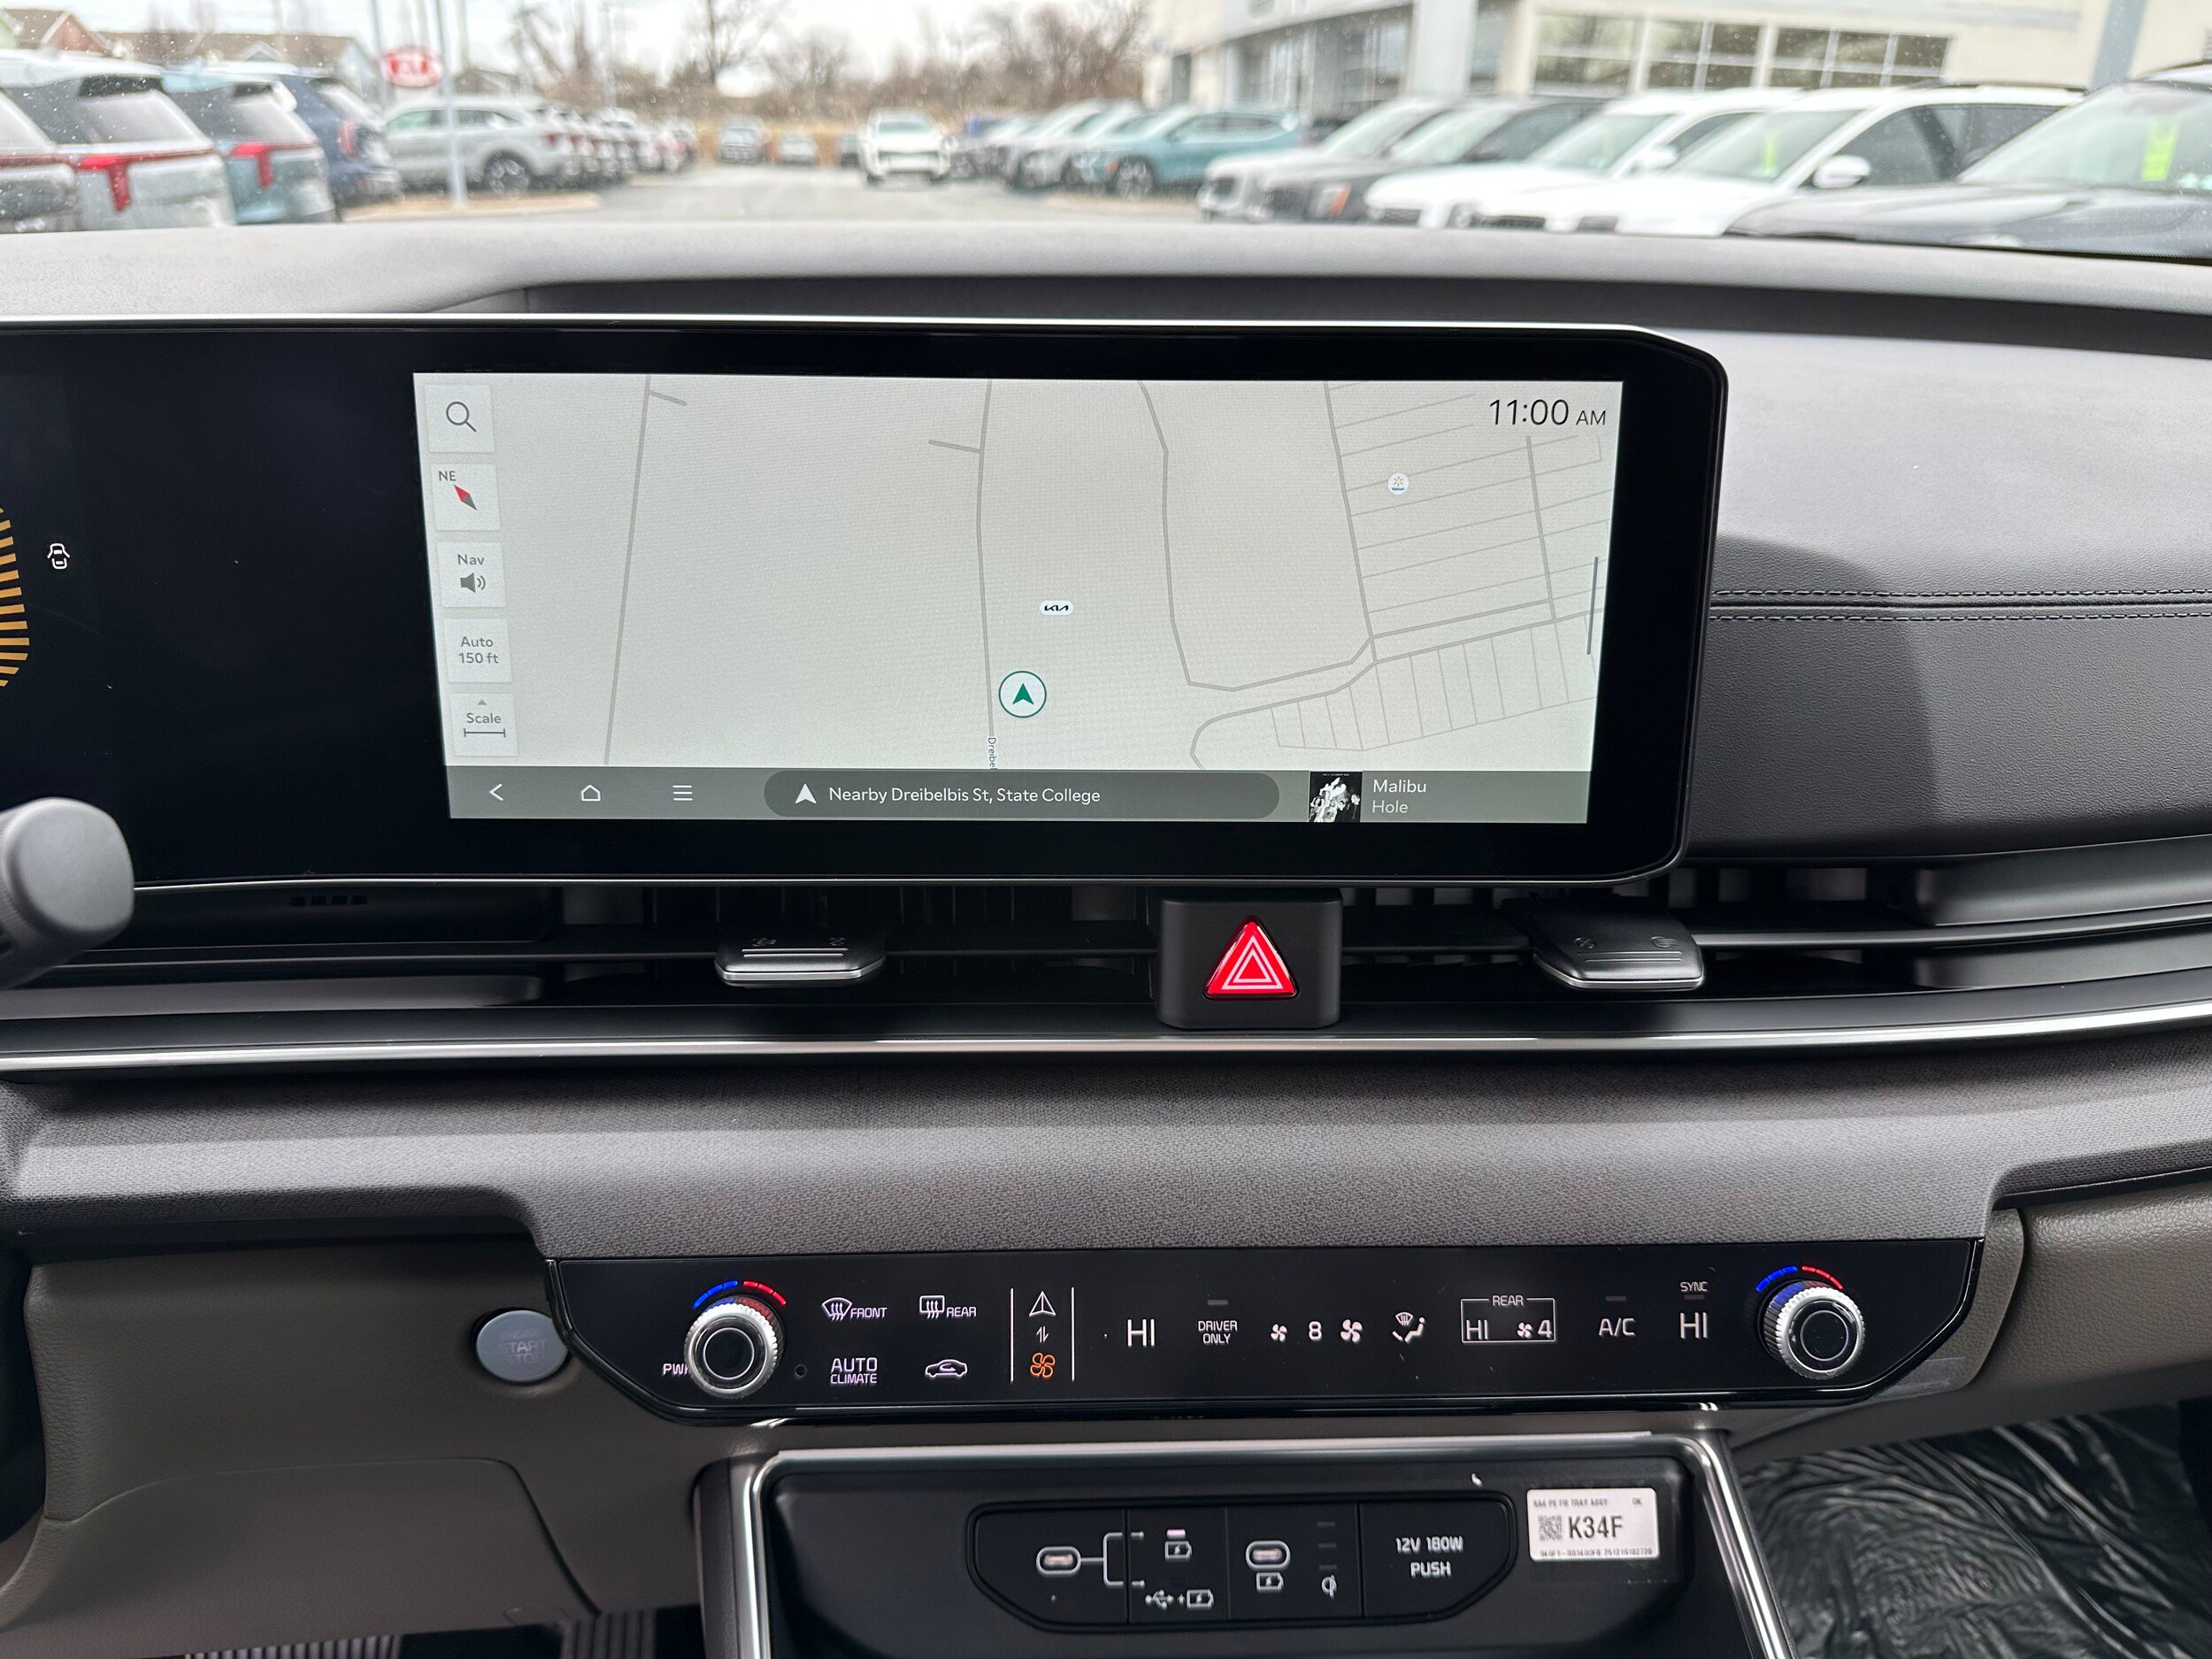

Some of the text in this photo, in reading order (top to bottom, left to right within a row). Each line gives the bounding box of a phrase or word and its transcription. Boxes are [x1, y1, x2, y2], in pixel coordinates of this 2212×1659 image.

[1489, 399, 1607, 426] 11:00 AM
[438, 470, 457, 481] NE
[457, 554, 485, 565] Nav
[460, 635, 494, 648] Auto
[458, 652, 499, 664] 150 ft
[466, 712, 502, 724] Scale
[1373, 779, 1427, 793] Malibu
[829, 787, 1101, 805] Nearby Dreibelbis St, State College
[1371, 800, 1409, 814] Hole
[1679, 1281, 1708, 1293] SYNC
[1492, 1294, 1524, 1307] REAR
[850, 1306, 887, 1319] FRONT
[946, 1305, 977, 1318] REAR
[1198, 1320, 1238, 1332] DRIVER
[1309, 1321, 1323, 1340] 8
[1466, 1319, 1489, 1340] HI
[1536, 1318, 1553, 1339] 4
[1598, 1317, 1635, 1337] A/C
[1679, 1311, 1708, 1339] HI
[1127, 1318, 1156, 1347] HI
[1202, 1333, 1232, 1344] ONLY
[831, 1356, 878, 1373] AUTO
[830, 1372, 878, 1385] CLIMATE
[1568, 1516, 1622, 1540] K34F
[1395, 1535, 1463, 1553] 12V 180W
[1410, 1561, 1452, 1577] PUSH
